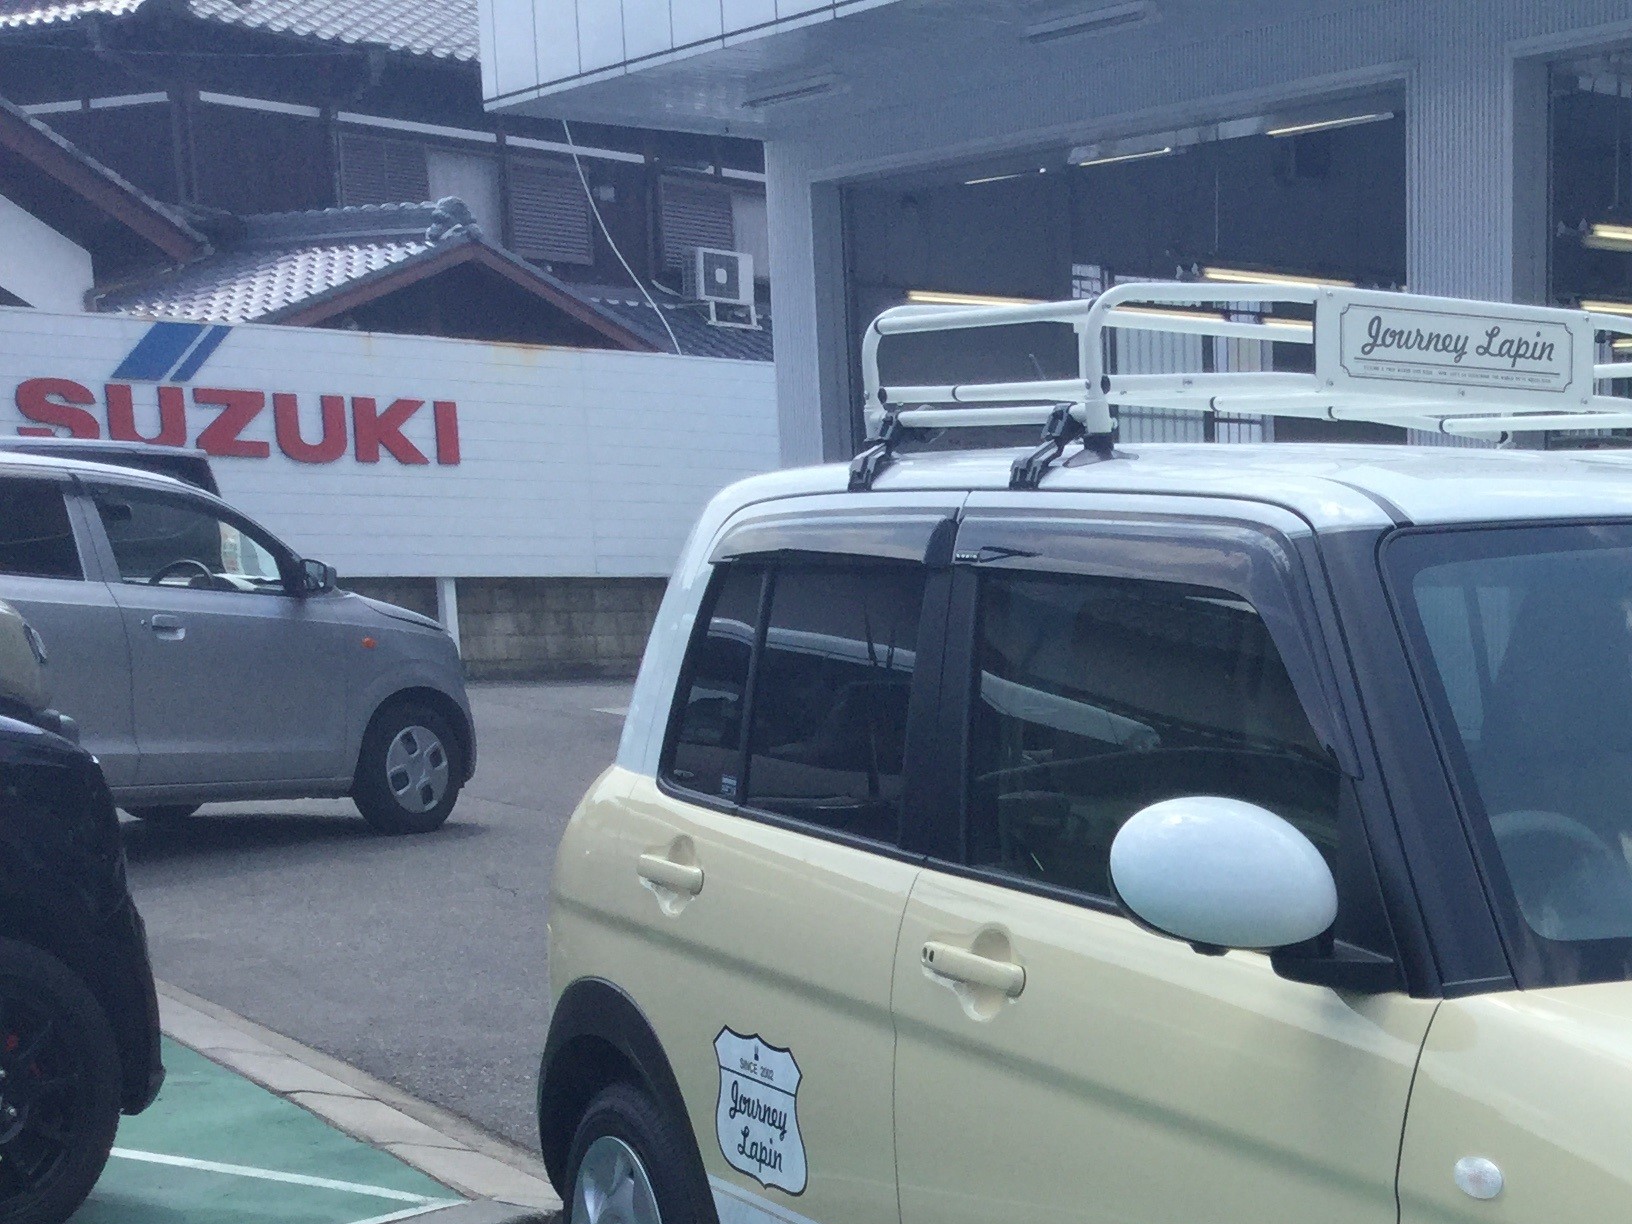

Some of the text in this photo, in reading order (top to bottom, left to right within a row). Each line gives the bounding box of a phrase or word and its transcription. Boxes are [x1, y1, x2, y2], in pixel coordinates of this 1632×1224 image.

[1361, 316, 1555, 367] Journey Lapin
[15, 377, 461, 466] SUZUKI
[729, 1080, 788, 1141] Journey
[737, 1126, 783, 1173] Lapin
